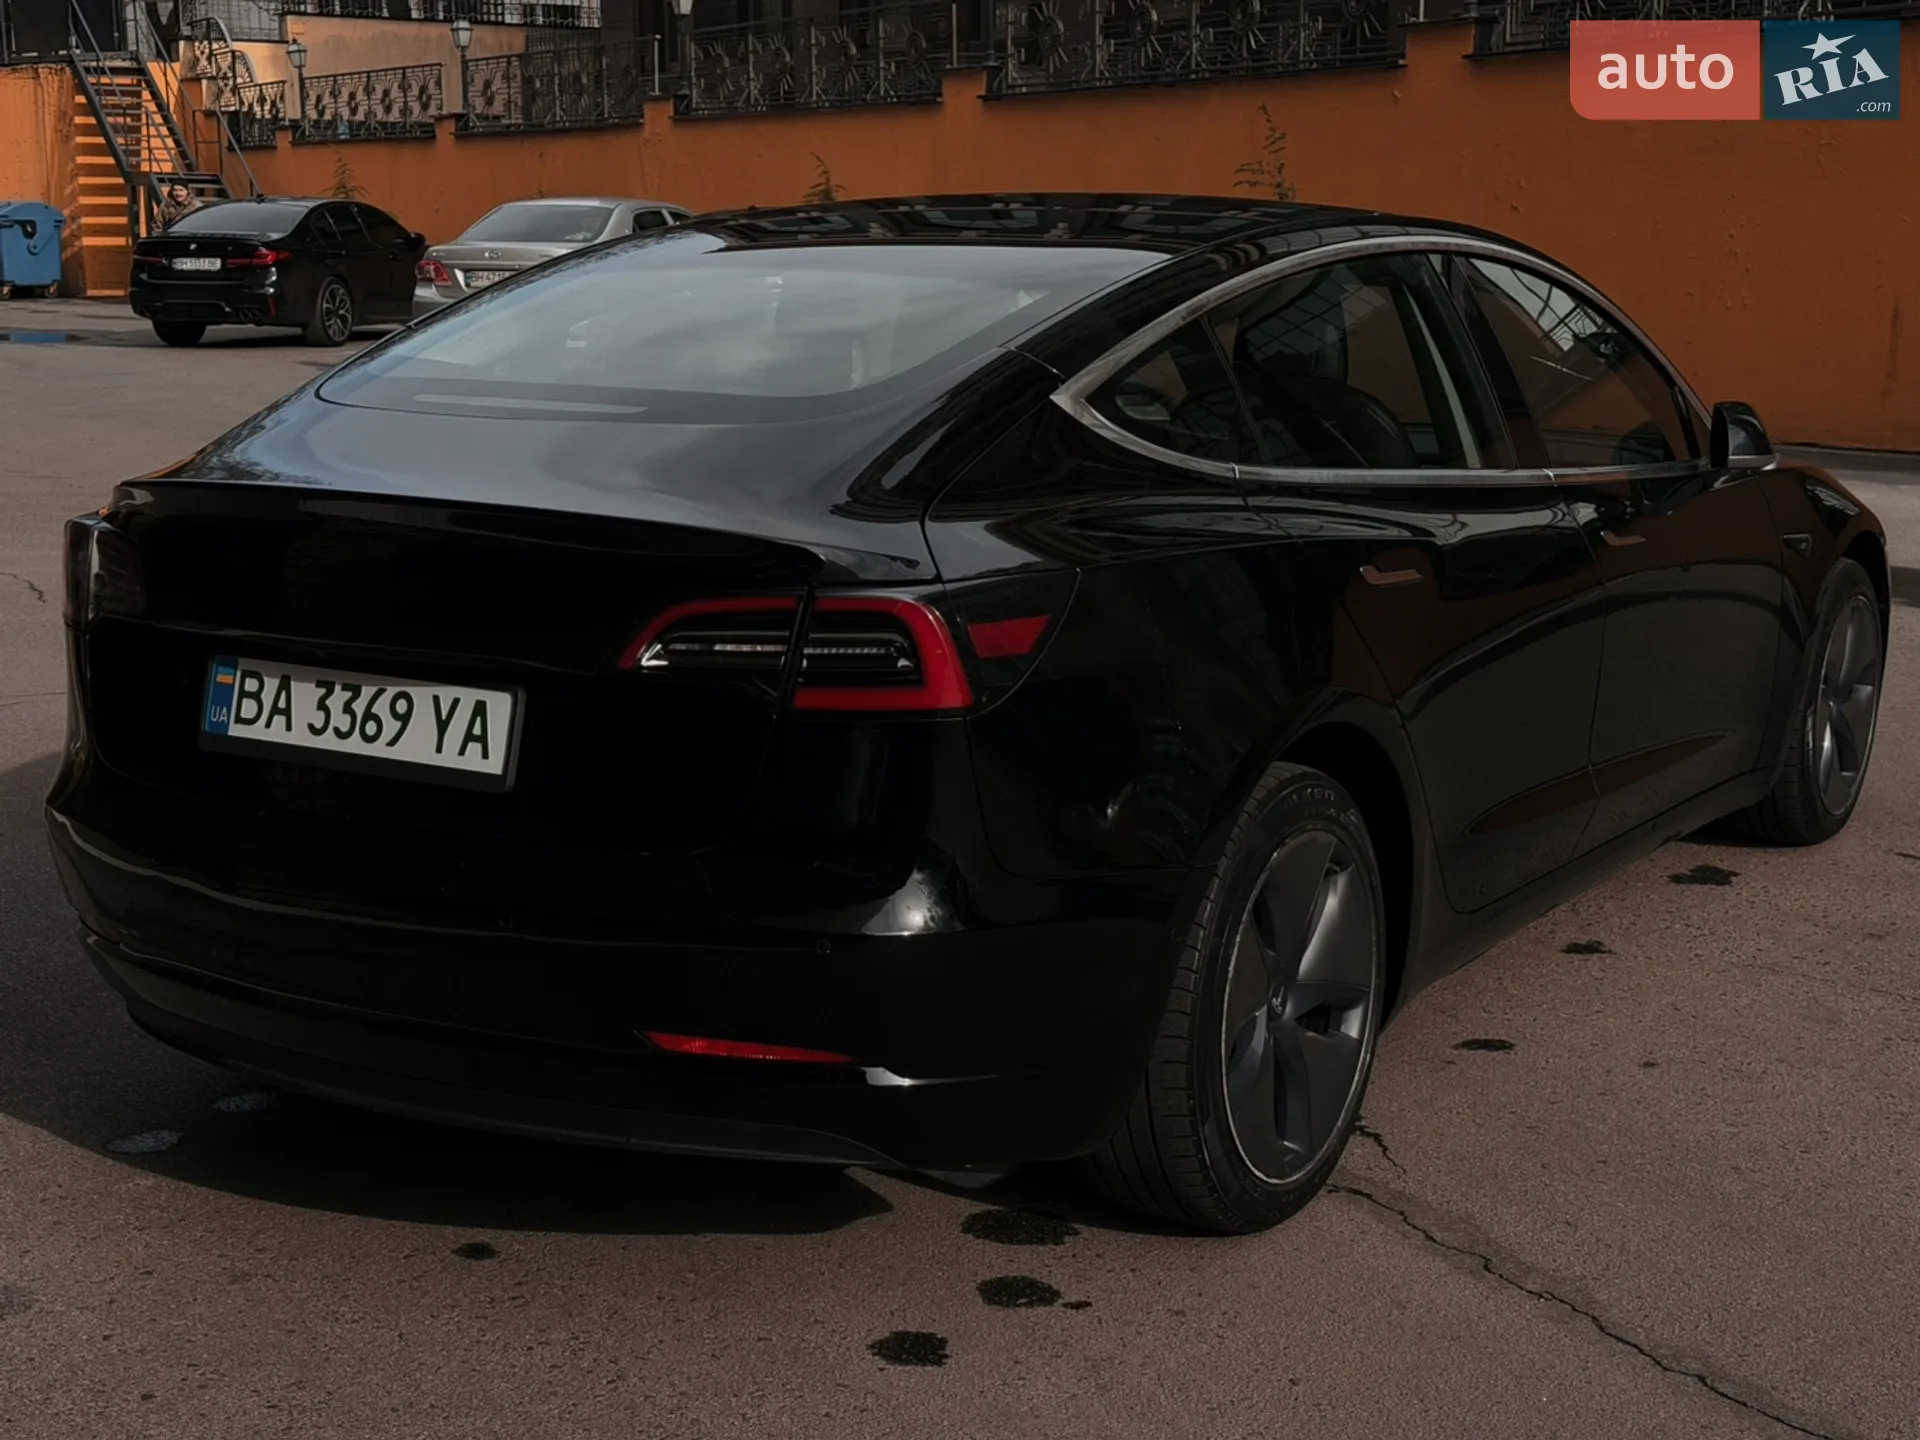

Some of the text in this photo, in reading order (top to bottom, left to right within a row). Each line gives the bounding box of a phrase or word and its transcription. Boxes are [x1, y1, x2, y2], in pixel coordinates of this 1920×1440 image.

[210, 705, 228, 724] UA
[233, 669, 490, 760] BA 3369 YA
